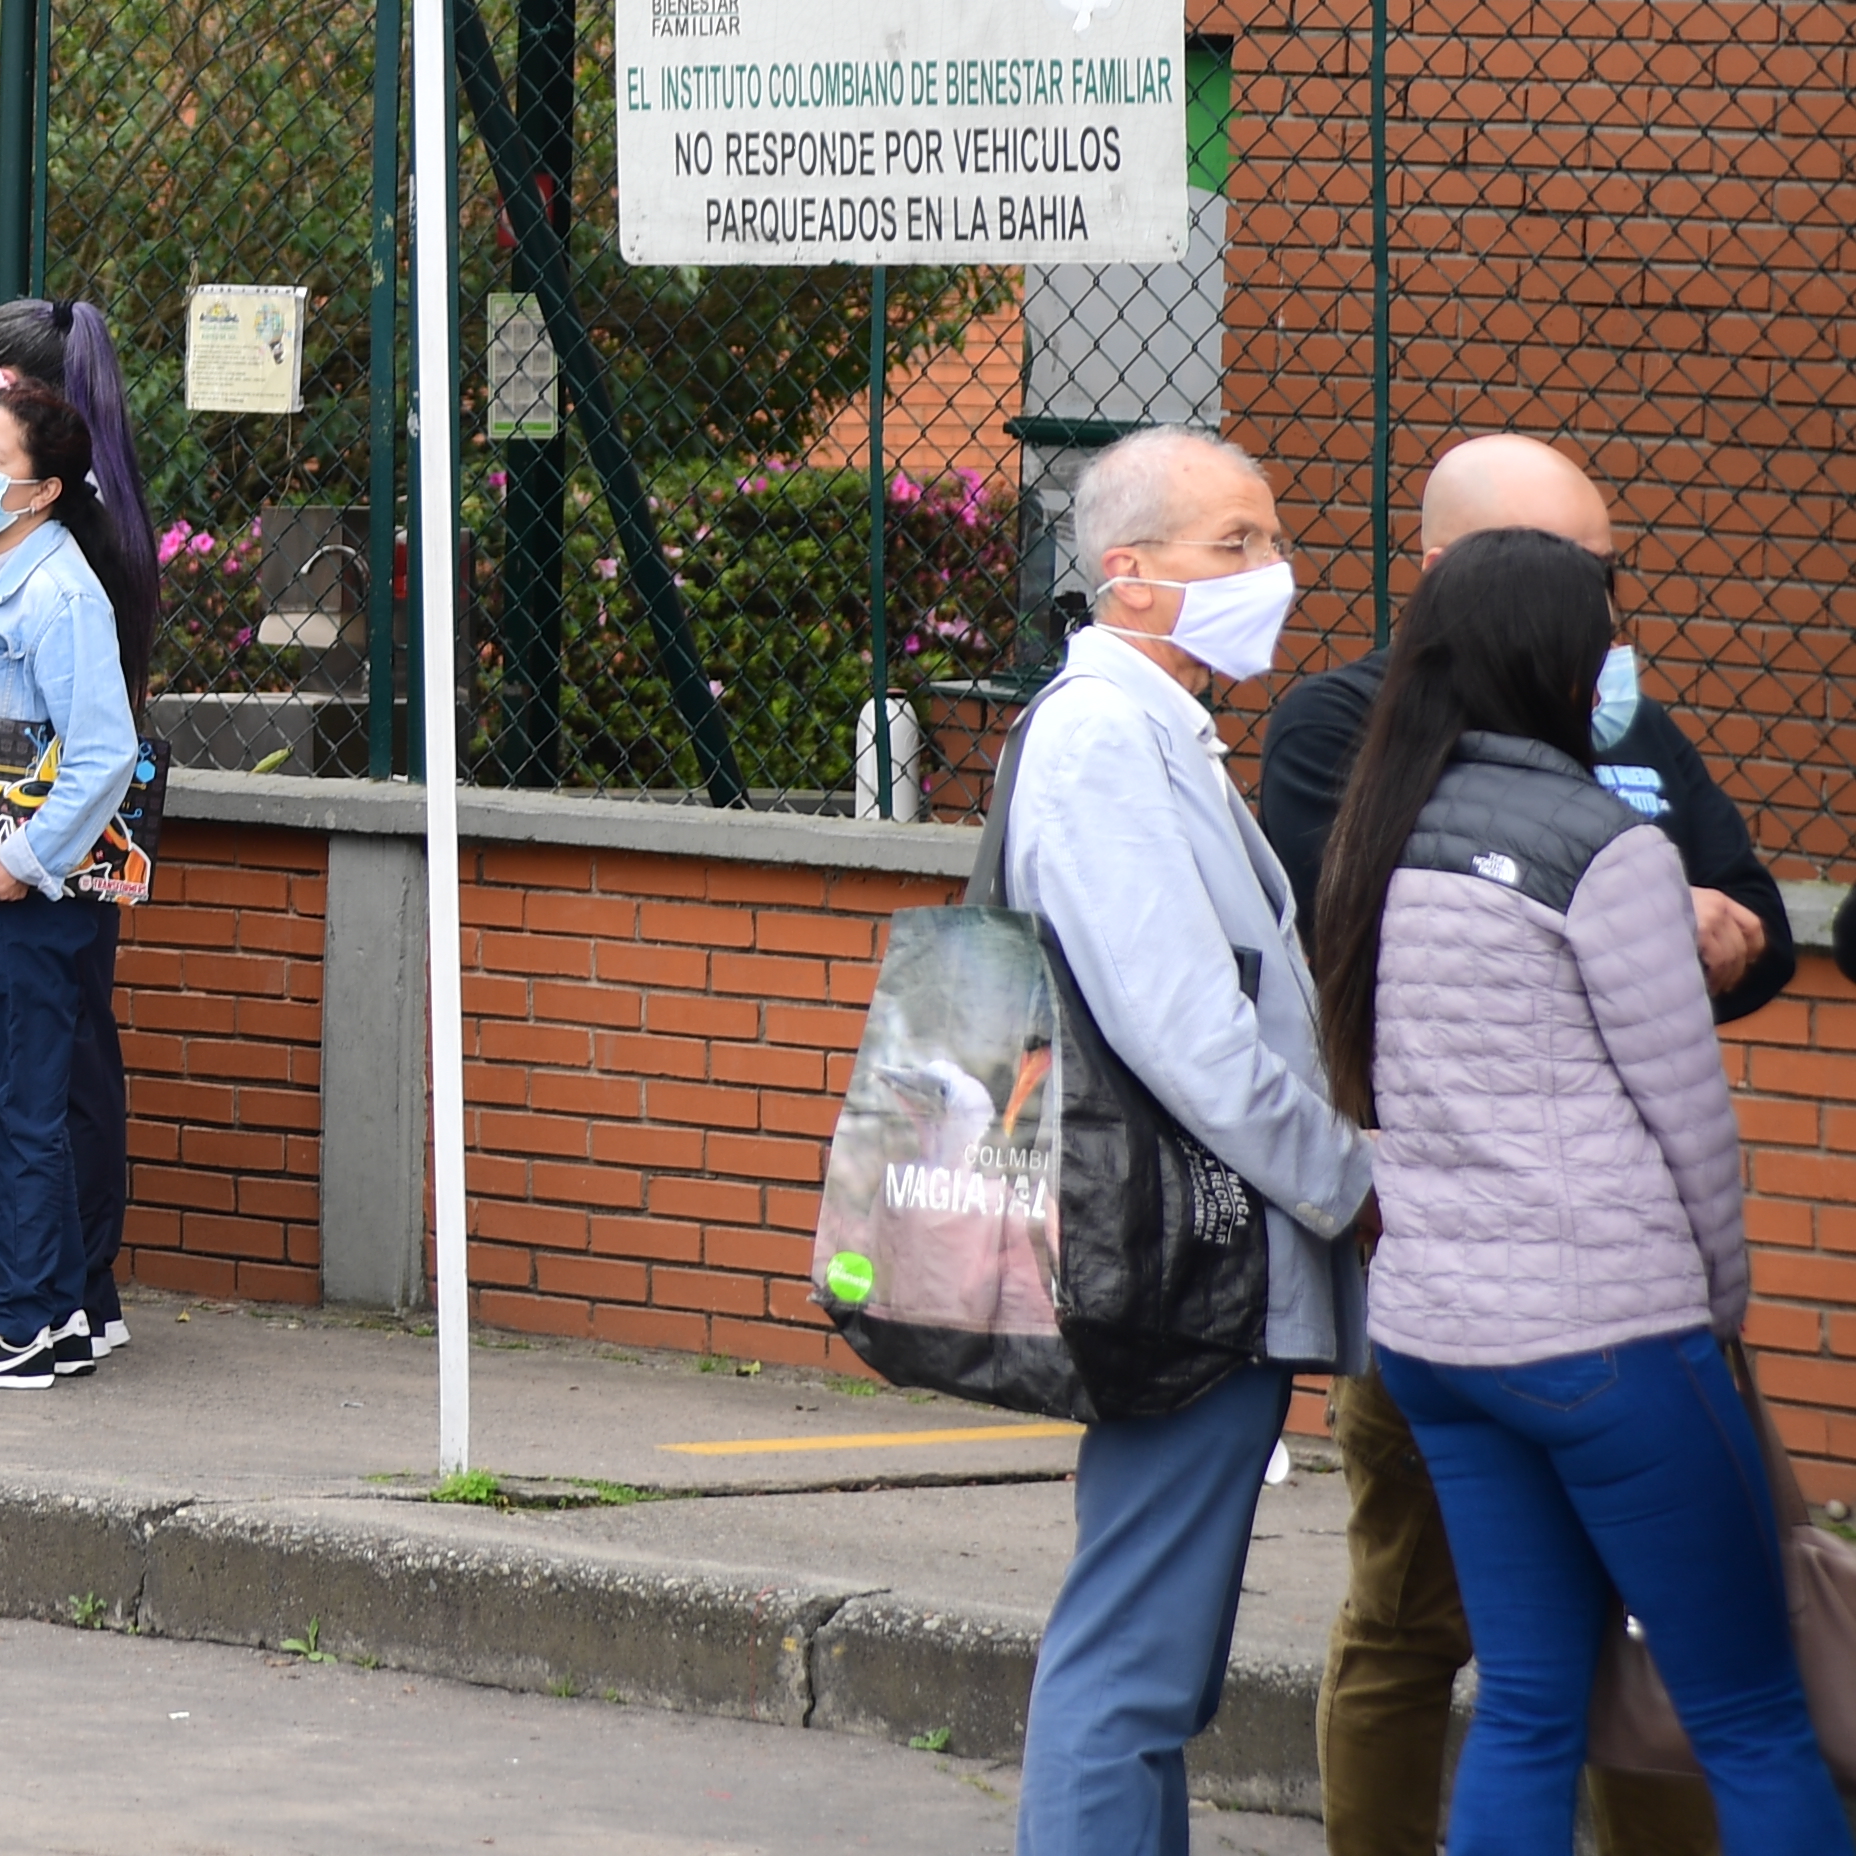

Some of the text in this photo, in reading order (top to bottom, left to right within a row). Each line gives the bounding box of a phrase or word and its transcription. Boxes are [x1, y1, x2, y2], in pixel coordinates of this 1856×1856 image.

[651, 15, 741, 38] FAMILIAR
[627, 55, 1173, 112] EL INSTITUTO COLOMBIANO DE BIENESTAR FAMILIAR
[674, 126, 1122, 178] NO RESPONDE POR VEHICULOS
[705, 195, 1089, 245] PARQUEADOS EN LA BAHIA
[886, 1162, 988, 1215] MAGIA
[1209, 1171, 1232, 1245] RECICLAR
